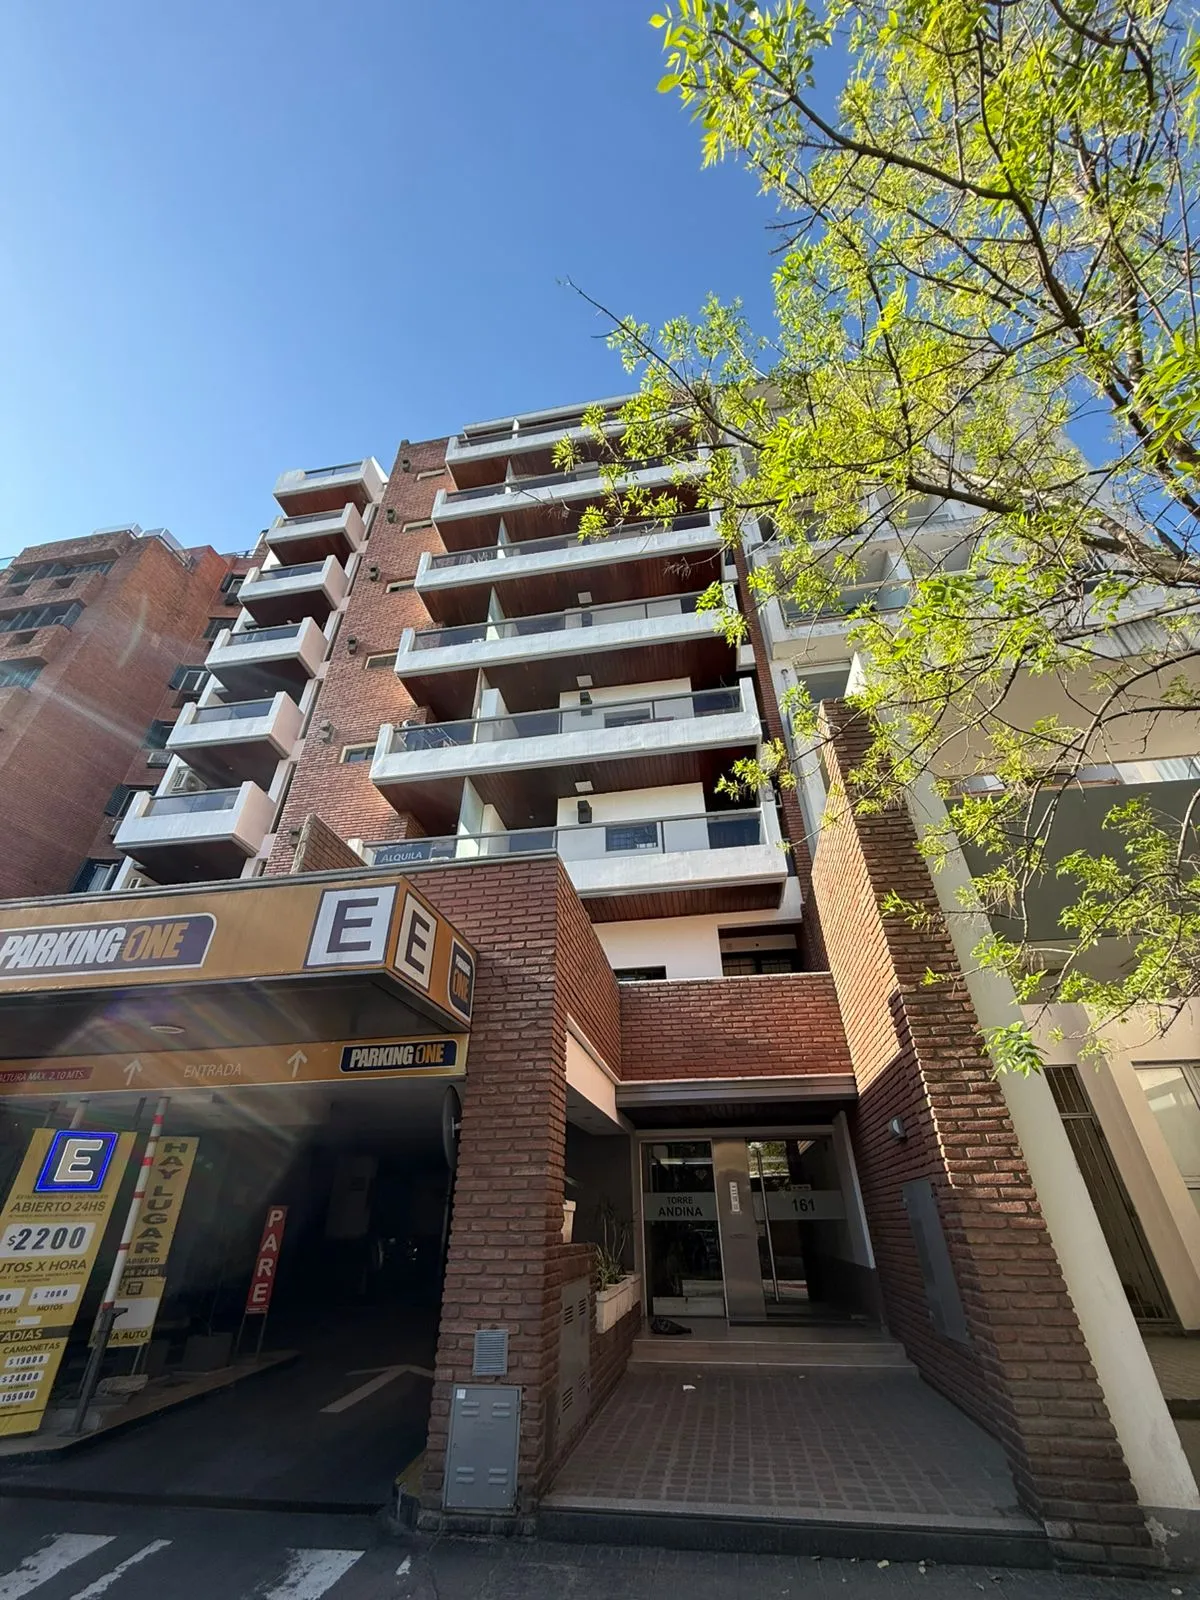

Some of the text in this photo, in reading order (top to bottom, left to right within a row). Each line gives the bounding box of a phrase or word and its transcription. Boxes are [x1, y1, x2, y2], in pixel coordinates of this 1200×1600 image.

[381, 850, 423, 863] ALQUILA
[326, 897, 379, 954] E
[0, 921, 190, 970] PARKING ONE
[404, 910, 431, 975] E
[349, 1043, 445, 1068] PARKING ONE
[184, 1063, 242, 1078] ENTRADA
[53, 1139, 104, 1183] E
[134, 1143, 189, 1255] HAY LUGAR
[667, 1196, 693, 1205] TORRE
[791, 1198, 816, 1213] 161
[10, 1201, 106, 1213] ABIERTO 24HS
[658, 1206, 703, 1218] ANDINA
[7, 1226, 87, 1251] $2200
[252, 1209, 284, 1303] PARE
[36, 1261, 46, 1272] X
[49, 1259, 87, 1271] HORA
[36, 1304, 64, 1312] MOTOS
[122, 1329, 148, 1340] AUTO
[3, 1342, 61, 1354] CAMIONETAS
